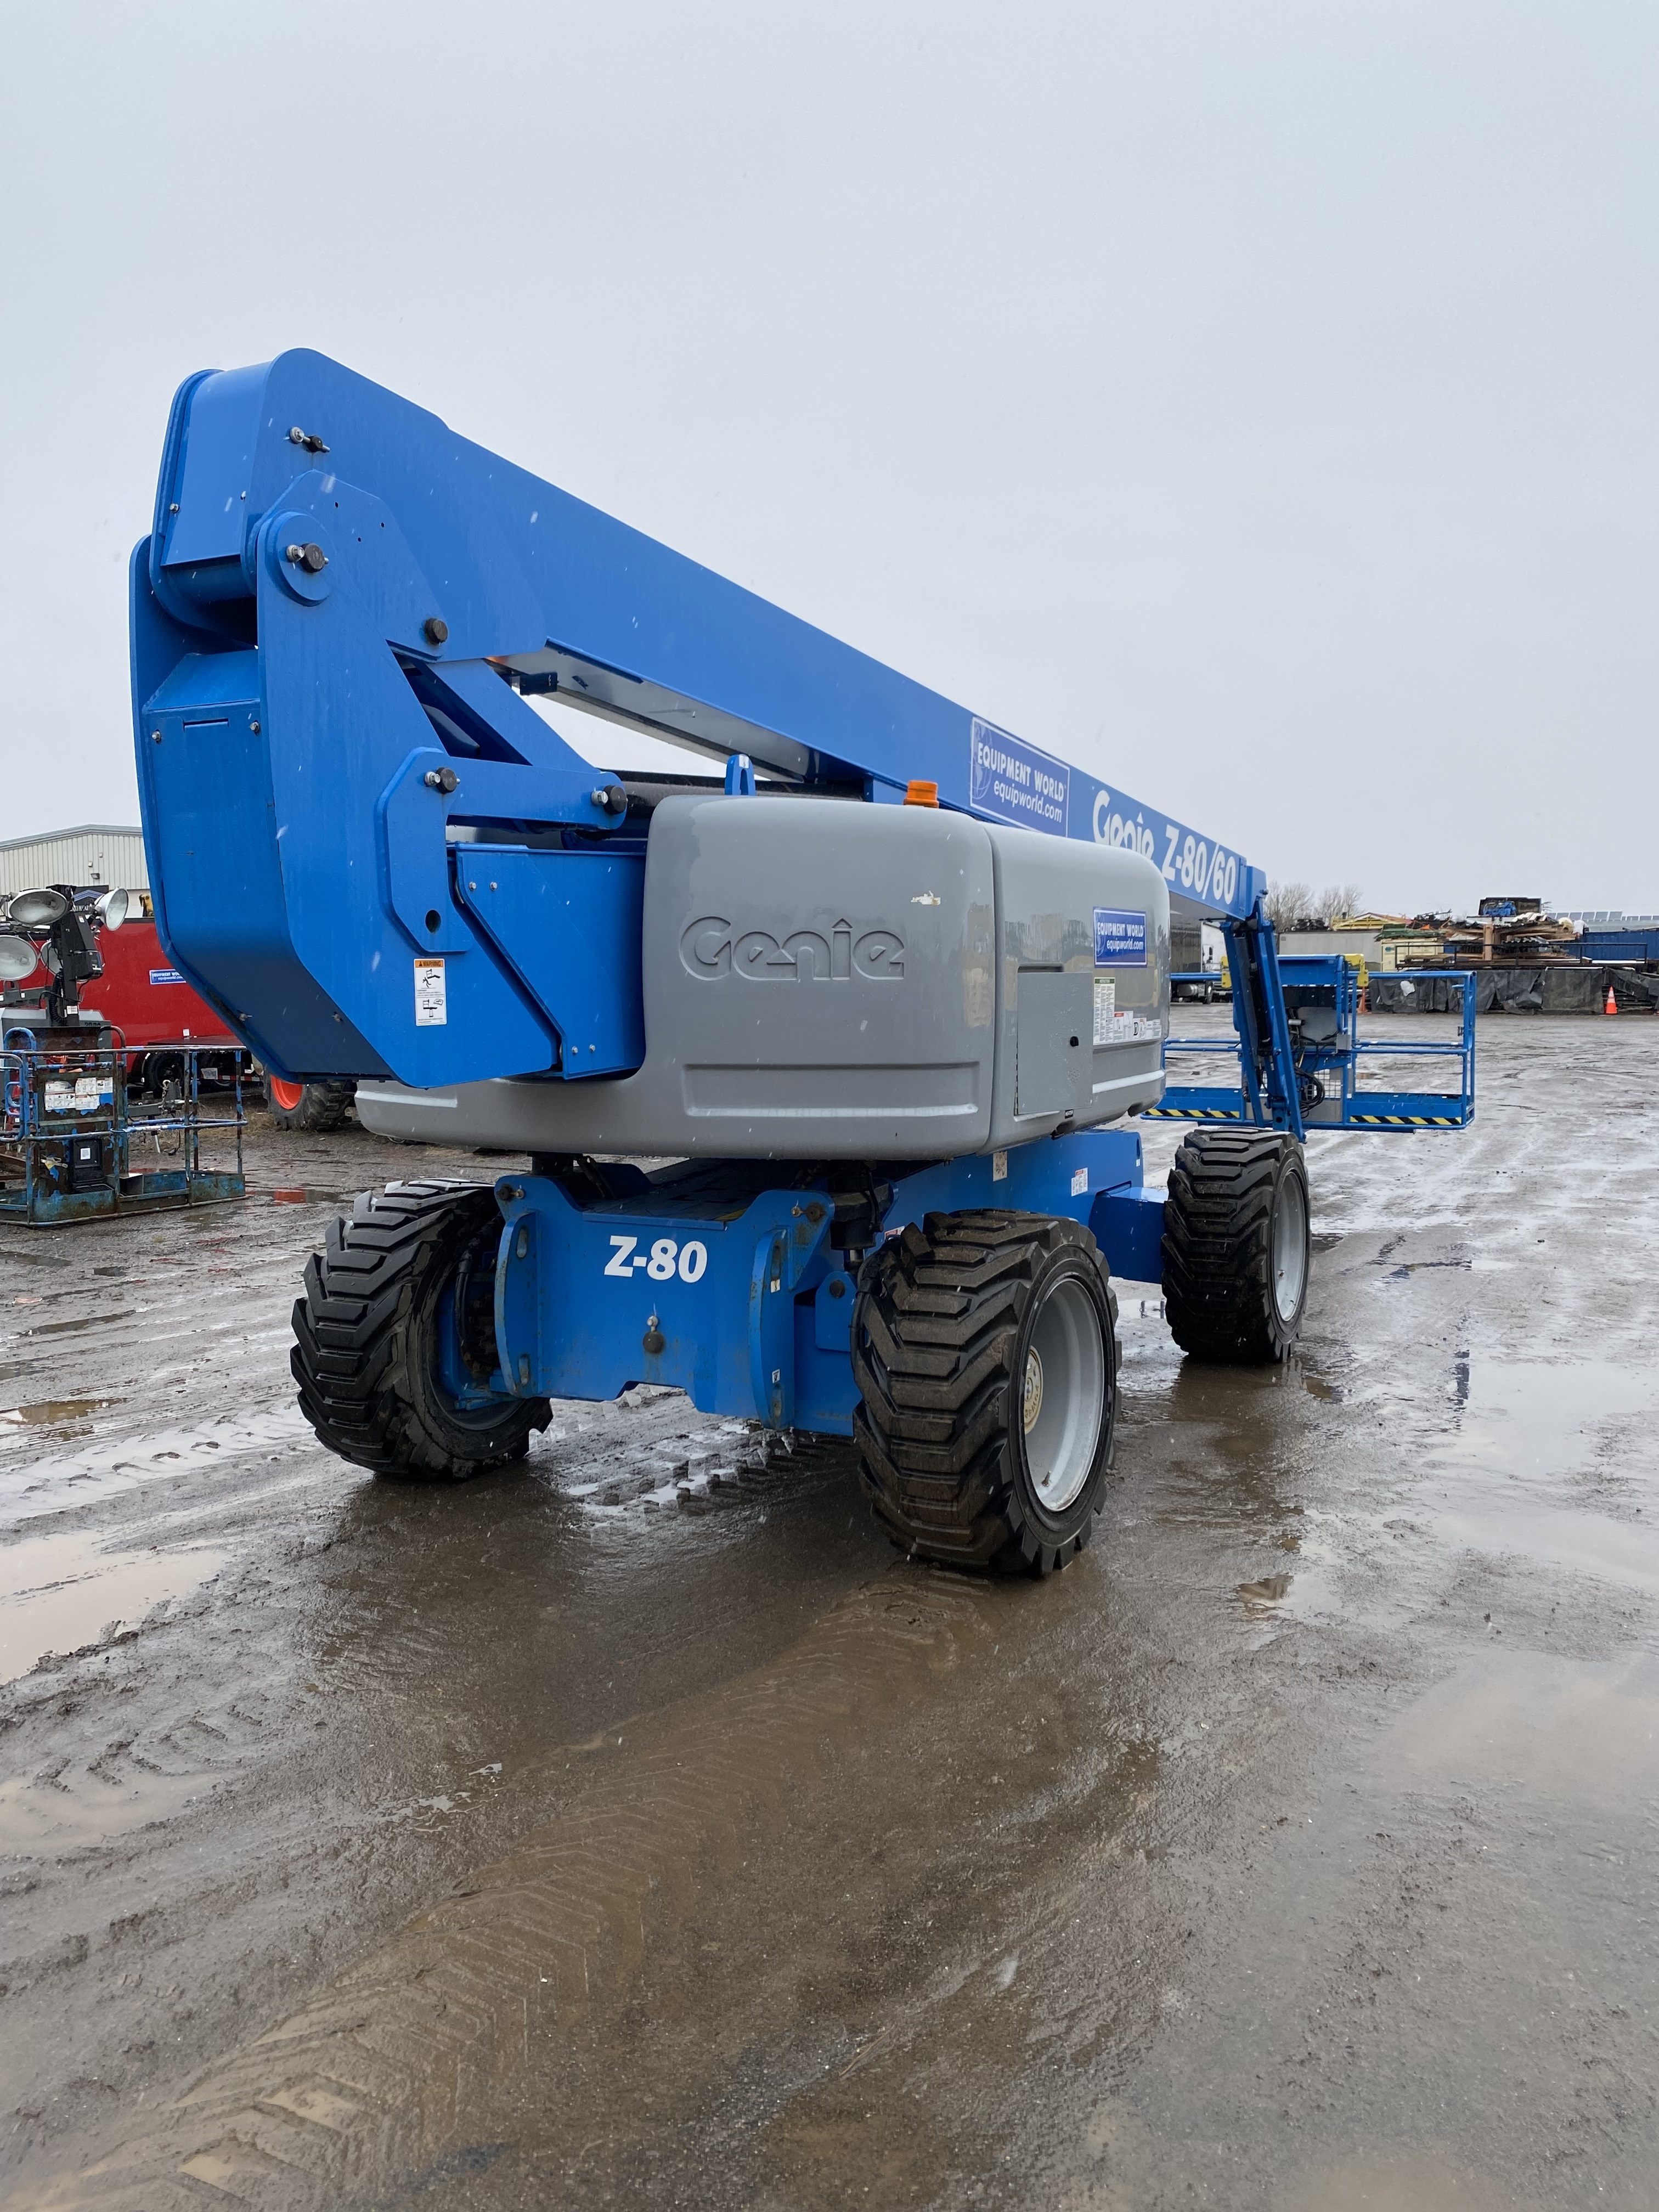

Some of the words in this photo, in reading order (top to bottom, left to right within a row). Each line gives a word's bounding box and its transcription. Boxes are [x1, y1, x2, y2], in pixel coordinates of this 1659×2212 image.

[978, 742, 1031, 787] EQUIPMENT
[1034, 770, 1064, 802] WORLD
[994, 780, 1062, 823] equipworld.com
[1161, 824, 1235, 905] Z-80/60
[680, 916, 905, 981] Genie
[1097, 922, 1125, 936] EQUIPMENT
[1126, 924, 1144, 937] WORLD
[1107, 938, 1143, 952] equipworld.com
[604, 1235, 708, 1283] Z-80
